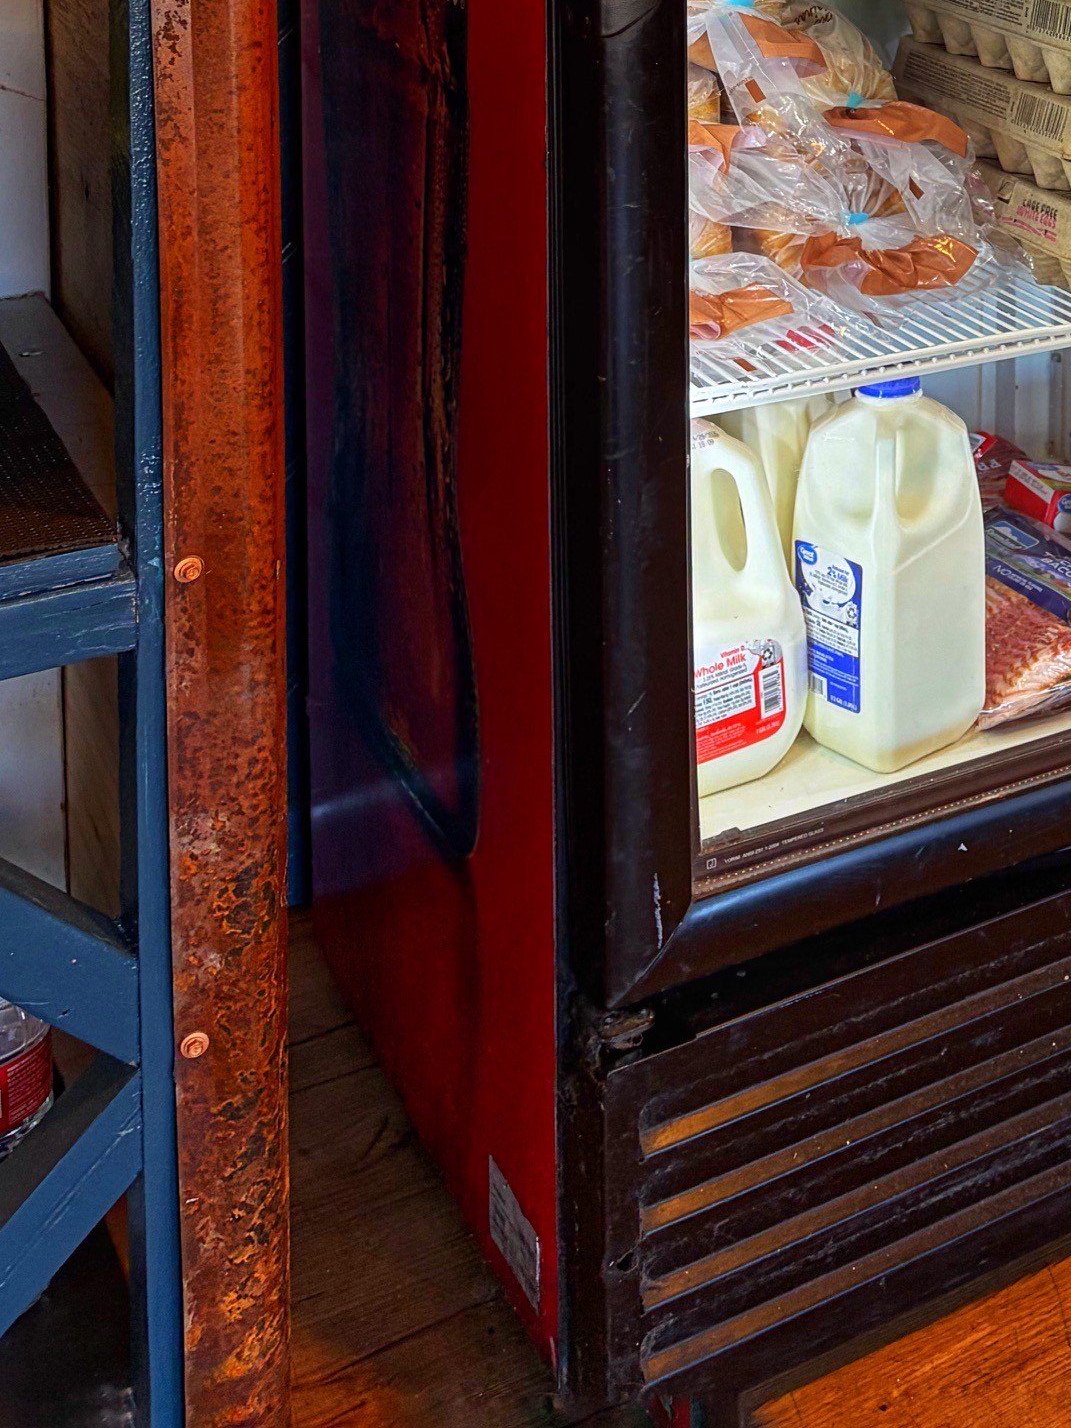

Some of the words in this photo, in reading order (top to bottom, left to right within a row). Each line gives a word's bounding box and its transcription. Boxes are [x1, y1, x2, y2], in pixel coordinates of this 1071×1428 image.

[1022, 199, 1040, 212] CAGE
[1041, 204, 1058, 220] FREE
[720, 647, 740, 659] Vitamin
[694, 662, 725, 679] Whole
[726, 654, 747, 667] Milk
